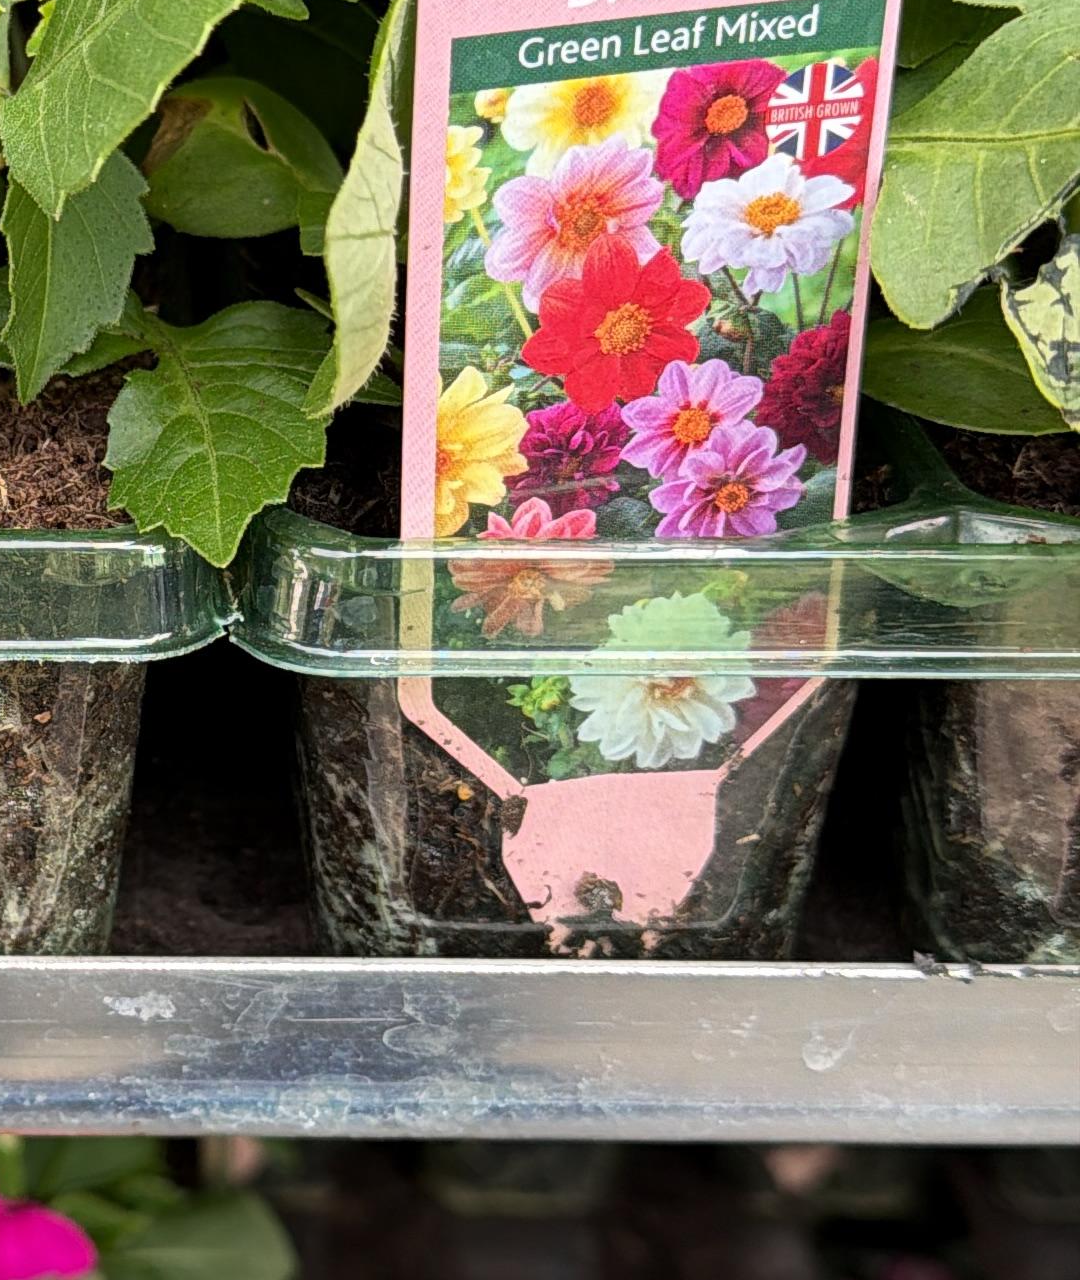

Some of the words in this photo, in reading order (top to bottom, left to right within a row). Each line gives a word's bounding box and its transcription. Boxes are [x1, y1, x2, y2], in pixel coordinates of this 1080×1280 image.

[518, 36, 622, 69] Green
[633, 16, 707, 56] Leaf
[714, 3, 820, 47] Mixed
[770, 104, 813, 123] BRITISH
[816, 99, 859, 119] GROWN
